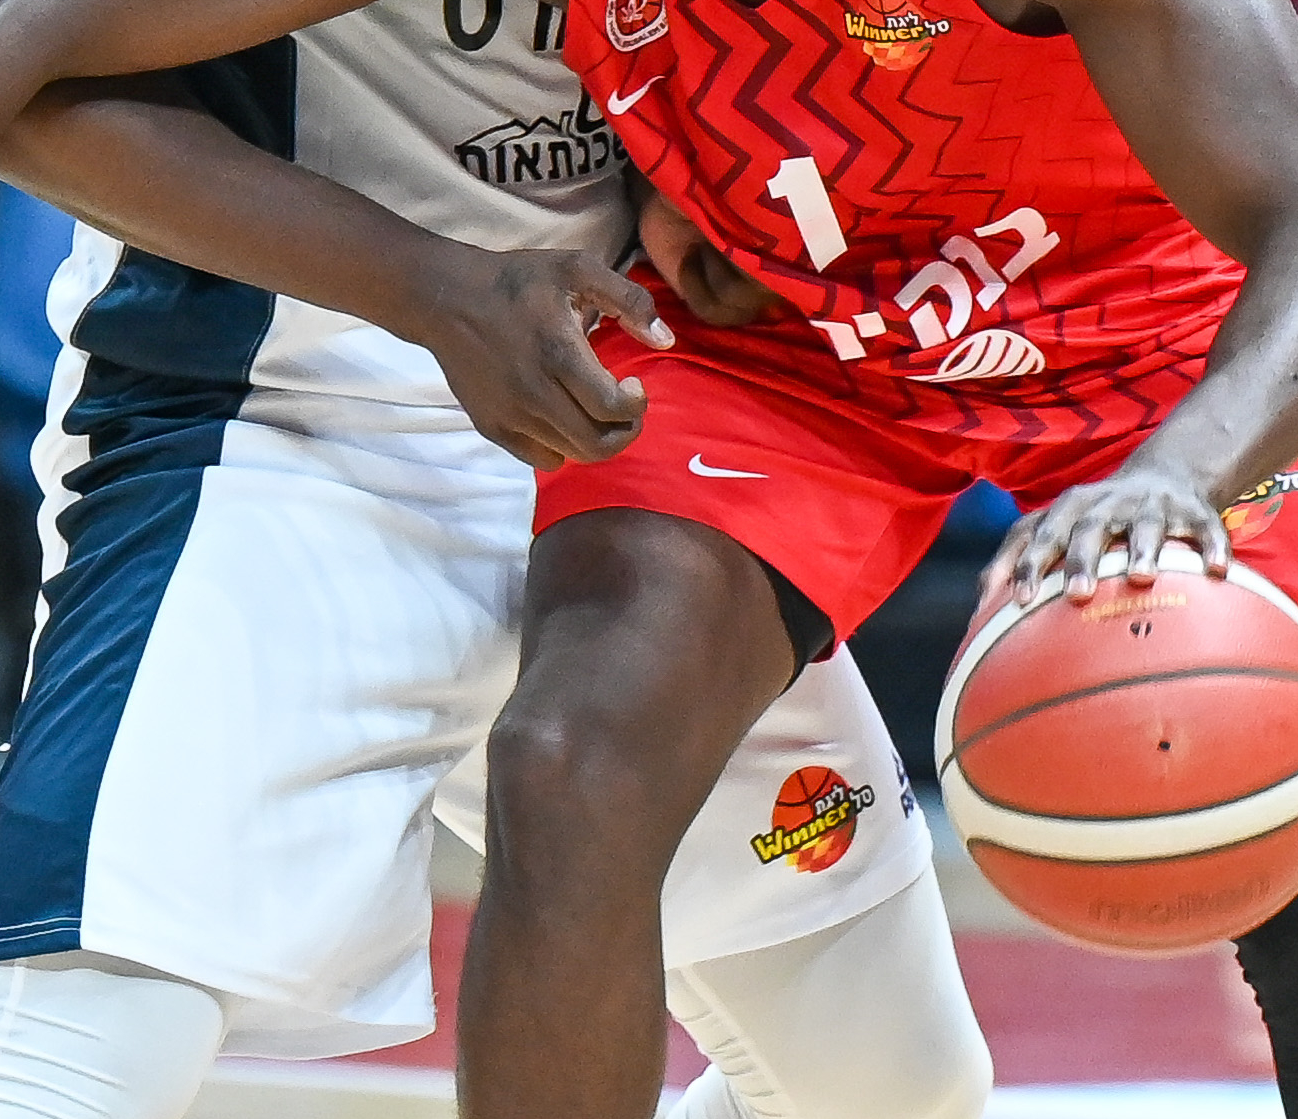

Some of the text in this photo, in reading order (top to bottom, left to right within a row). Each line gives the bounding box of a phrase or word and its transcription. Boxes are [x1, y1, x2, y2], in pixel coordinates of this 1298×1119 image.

[845, 13, 950, 41] Winner סל
[886, 12, 919, 29] ליגת
[766, 156, 849, 274] 1
[815, 784, 846, 815] ליגת
[754, 787, 874, 862] Winner סל
